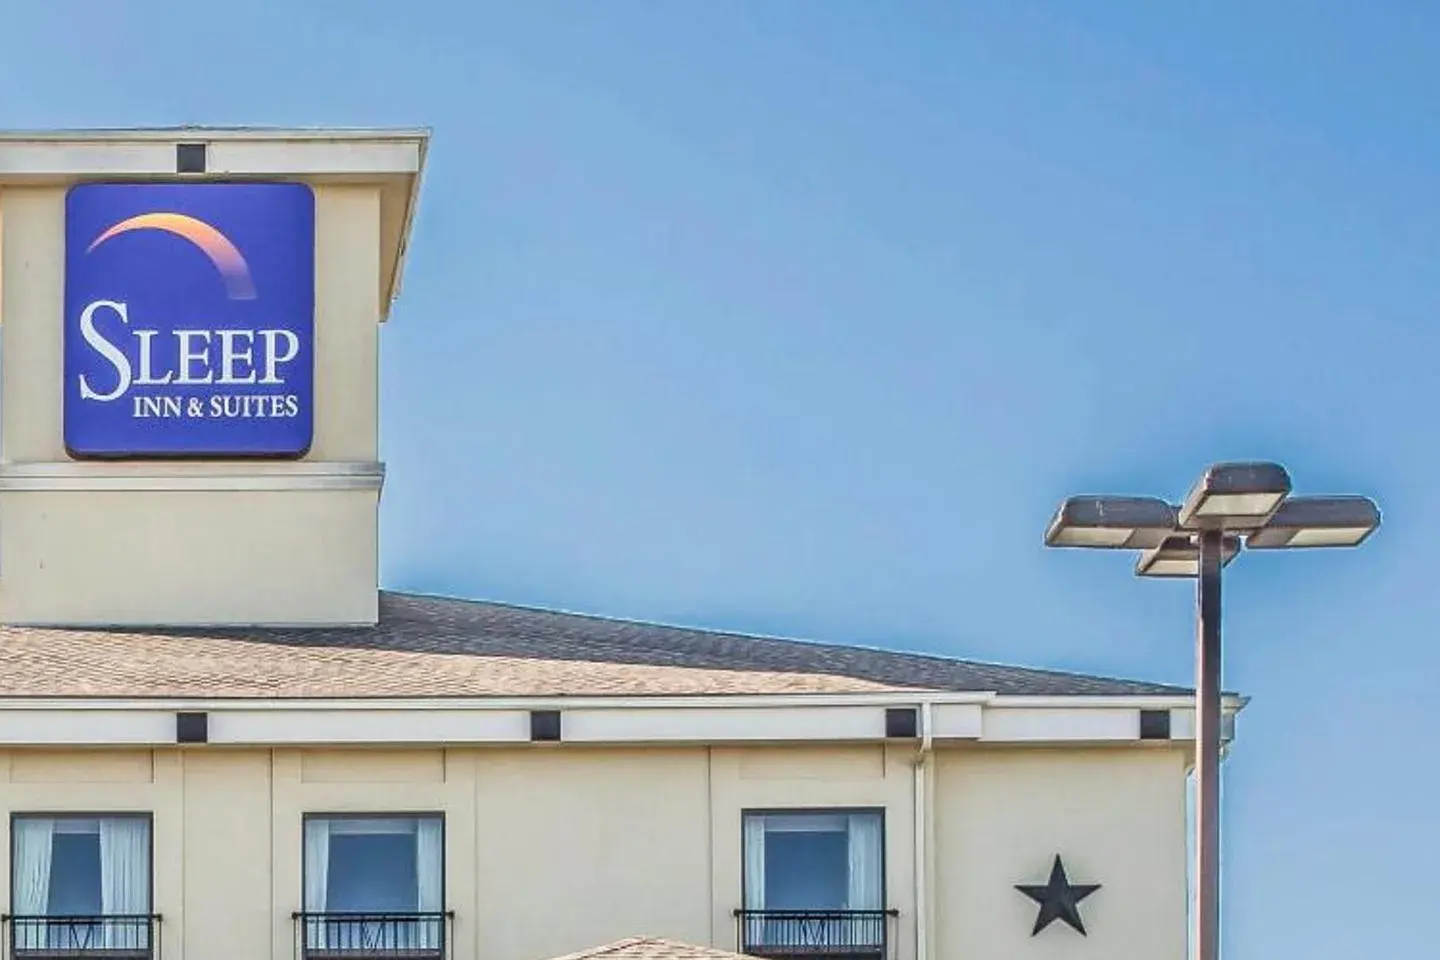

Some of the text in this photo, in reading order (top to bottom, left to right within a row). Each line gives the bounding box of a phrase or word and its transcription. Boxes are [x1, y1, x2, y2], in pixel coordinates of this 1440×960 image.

[78, 299, 300, 402] SLEEP
[133, 395, 299, 418] INN & SUITES
